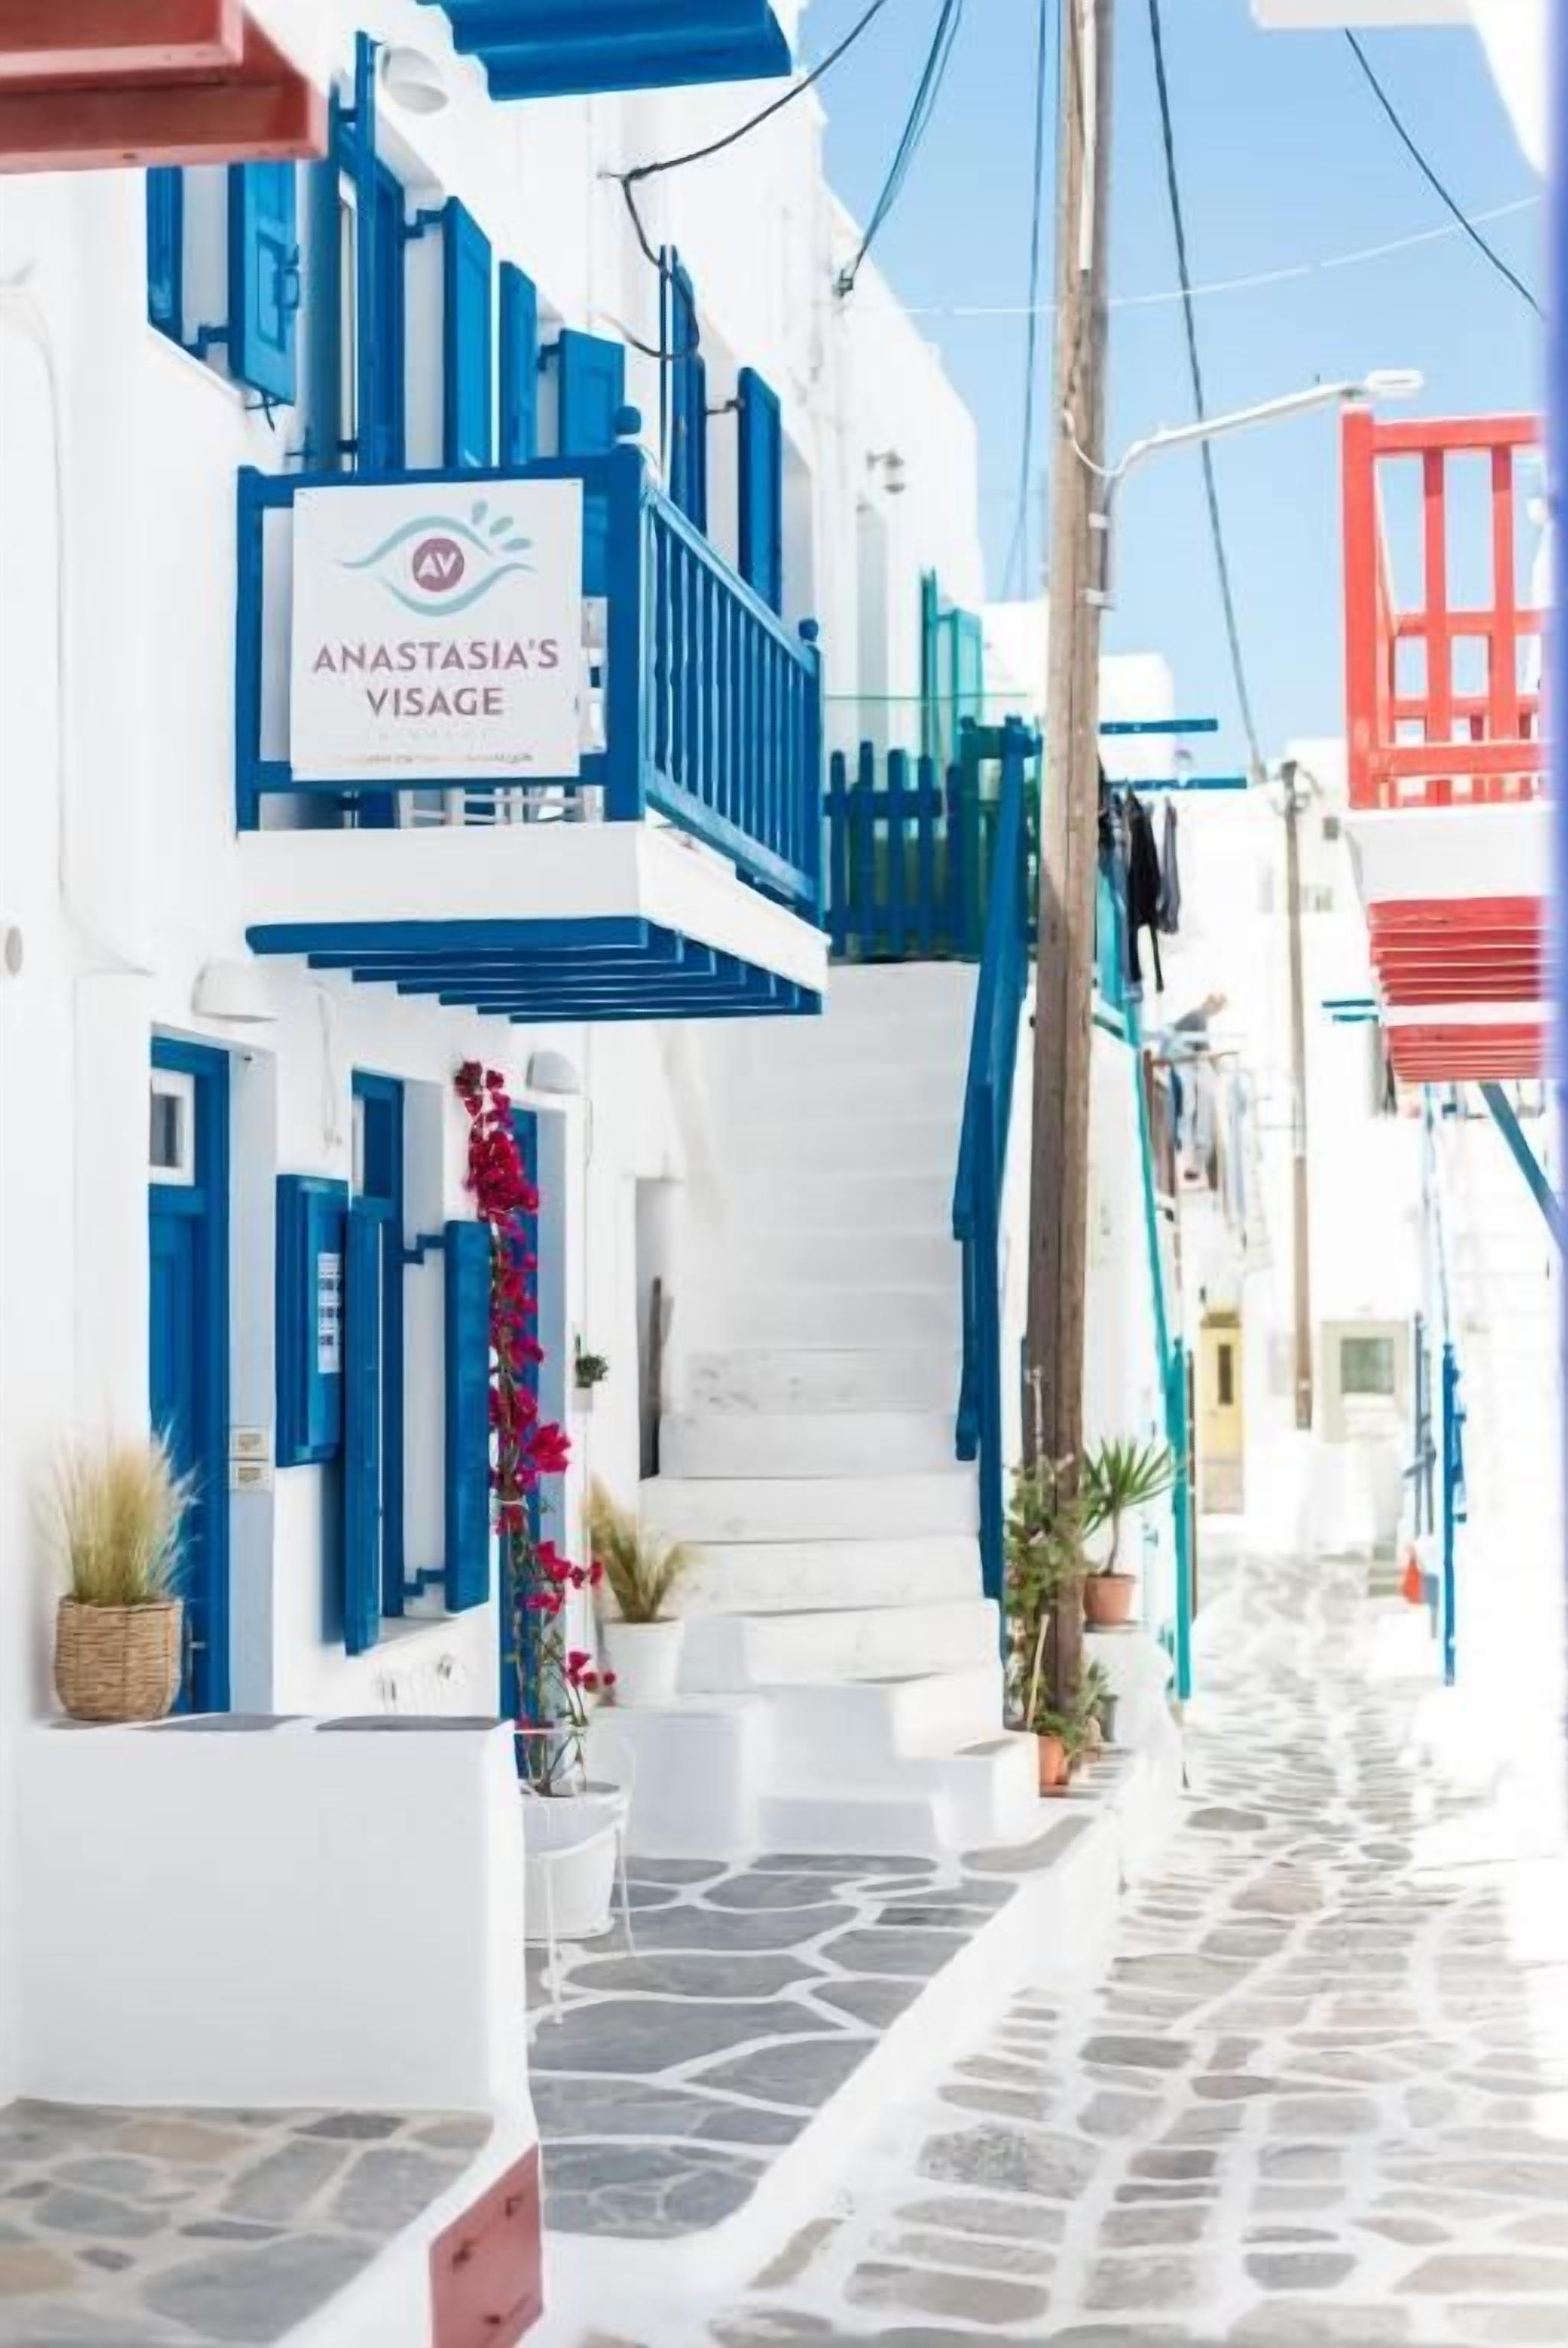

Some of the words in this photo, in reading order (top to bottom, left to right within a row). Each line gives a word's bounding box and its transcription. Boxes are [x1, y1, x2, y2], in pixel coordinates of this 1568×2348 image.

[416, 552, 457, 579] AV
[313, 639, 559, 673] ANASTASIA'S
[366, 687, 504, 716] VISAGE
